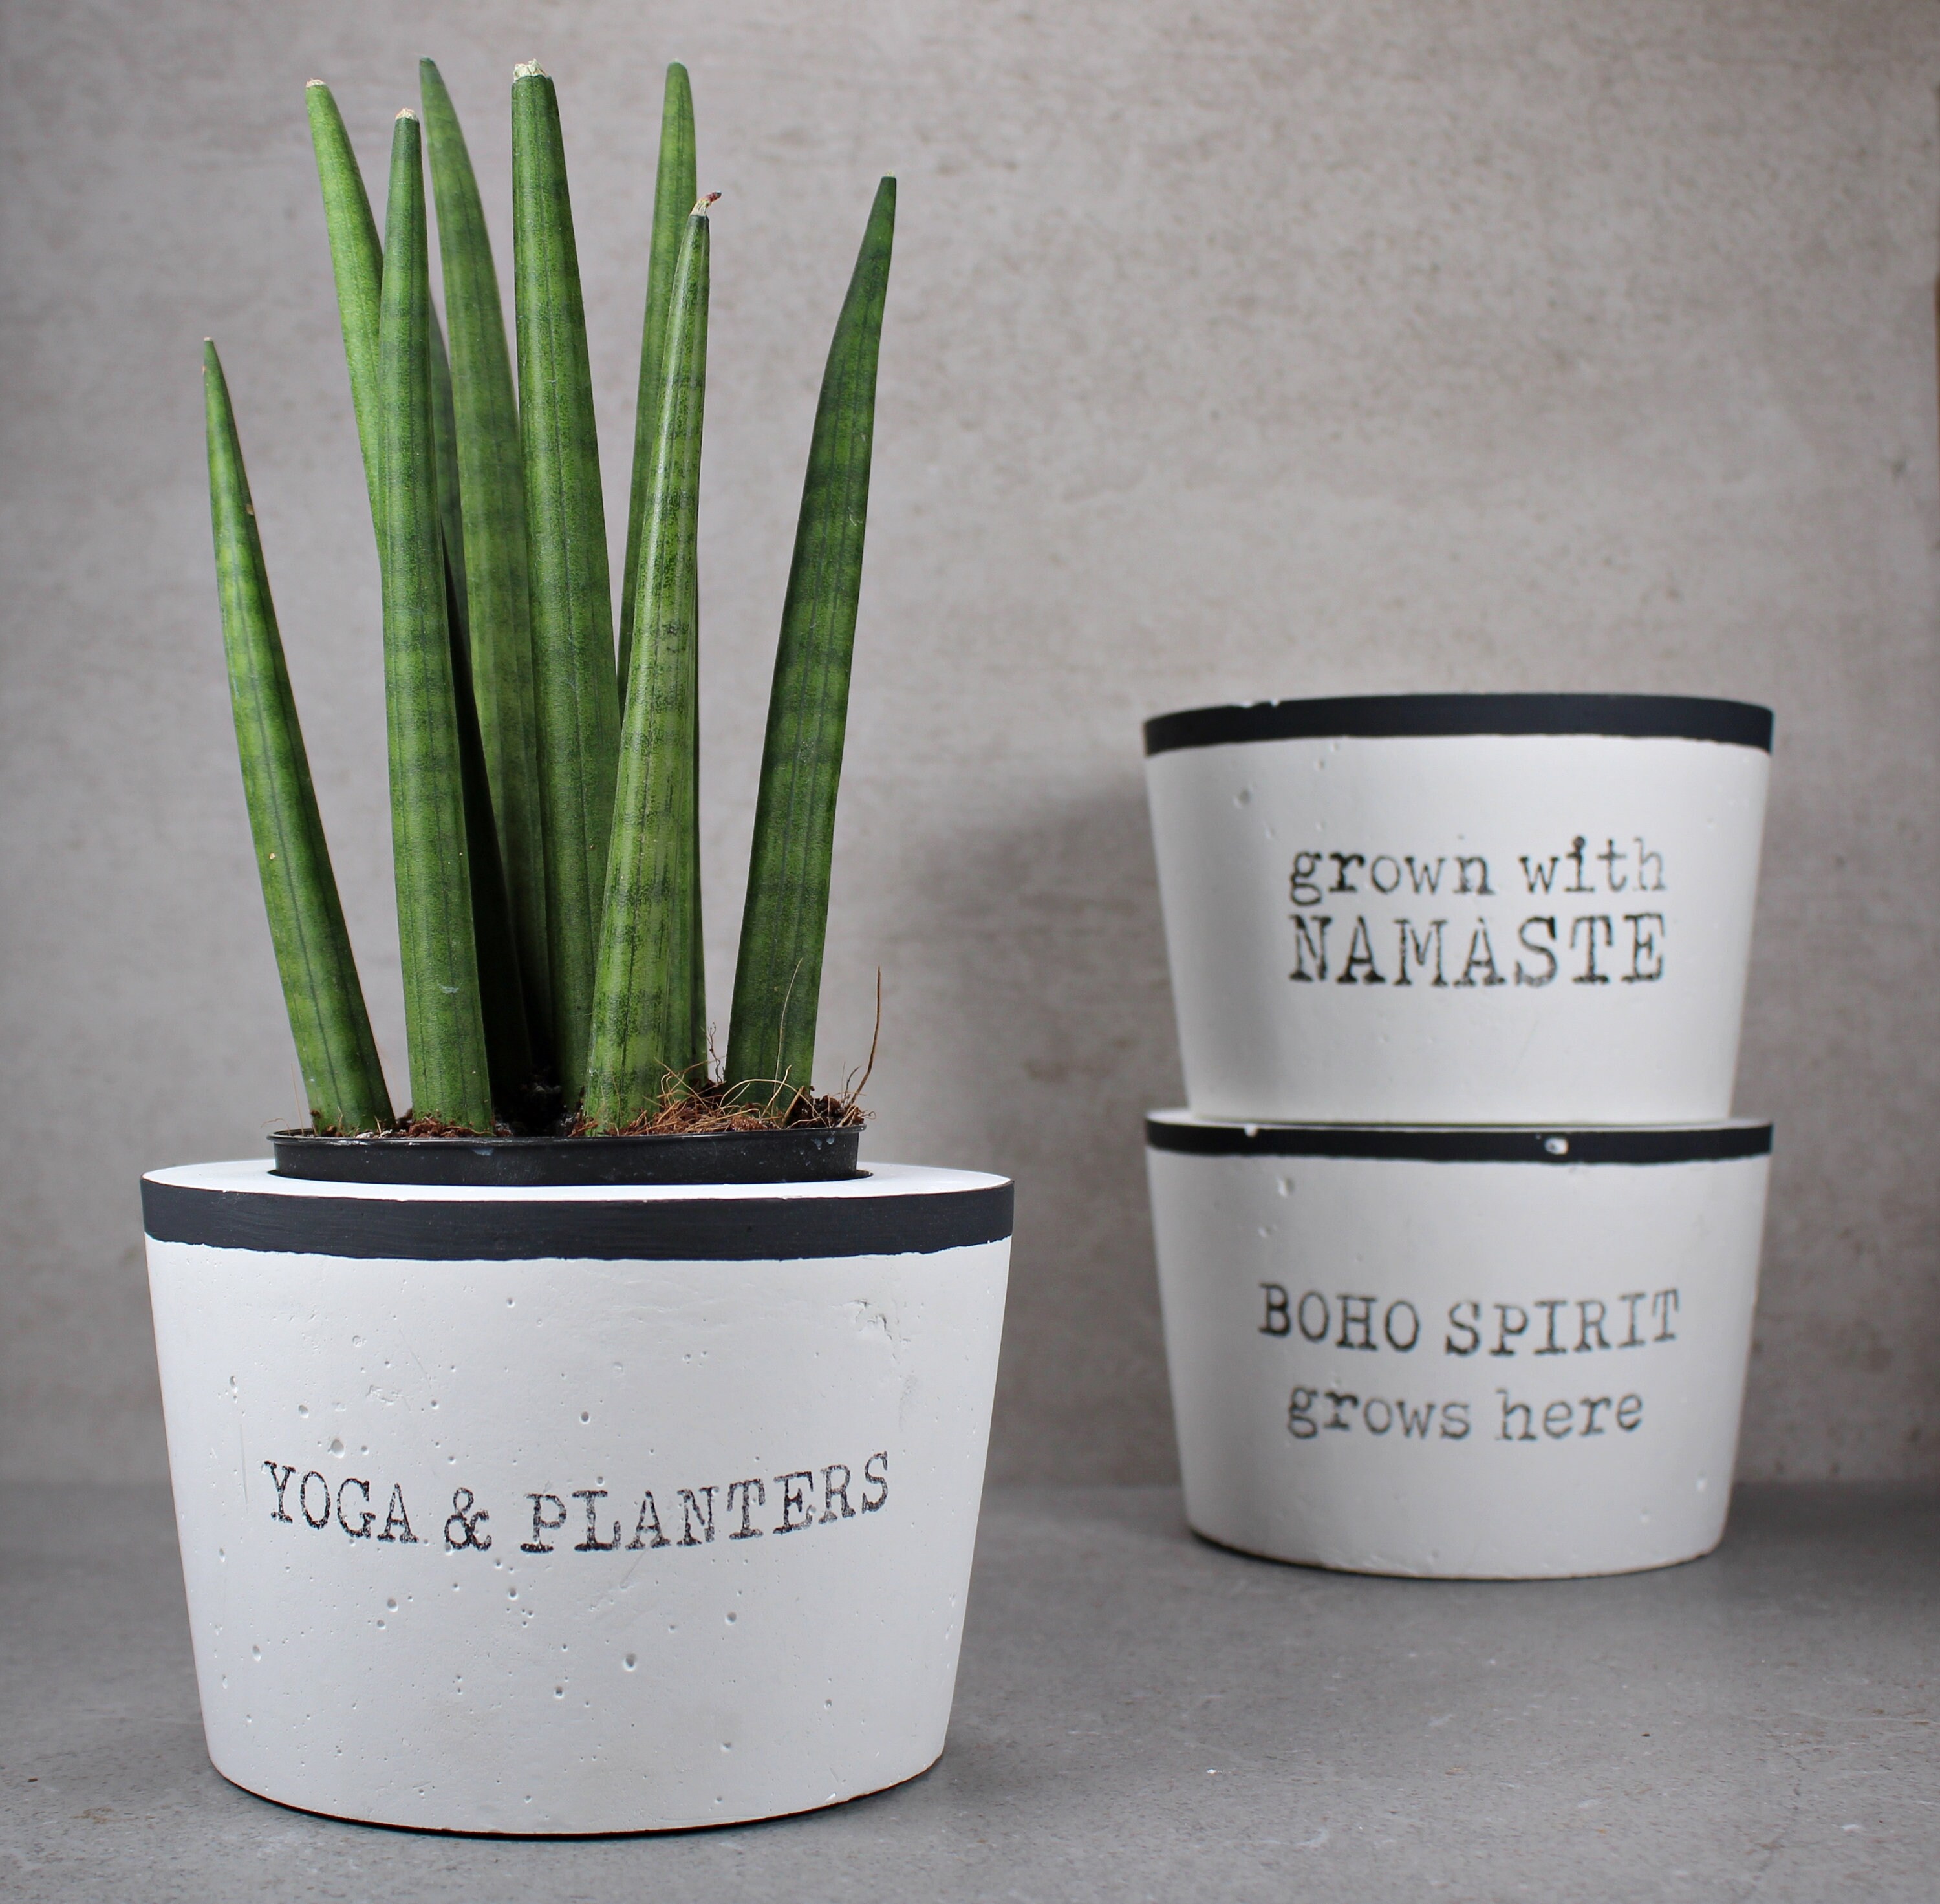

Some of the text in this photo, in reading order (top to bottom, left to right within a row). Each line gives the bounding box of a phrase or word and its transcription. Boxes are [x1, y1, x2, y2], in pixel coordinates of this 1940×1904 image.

[1289, 835, 1668, 907] grown with
[1289, 912, 1666, 988] NAMASTE
[1258, 1282, 1679, 1358] BOHO SPIRIT
[1287, 1385, 1643, 1441] grows here
[263, 1449, 889, 1554] YOGA & PLANTERS
